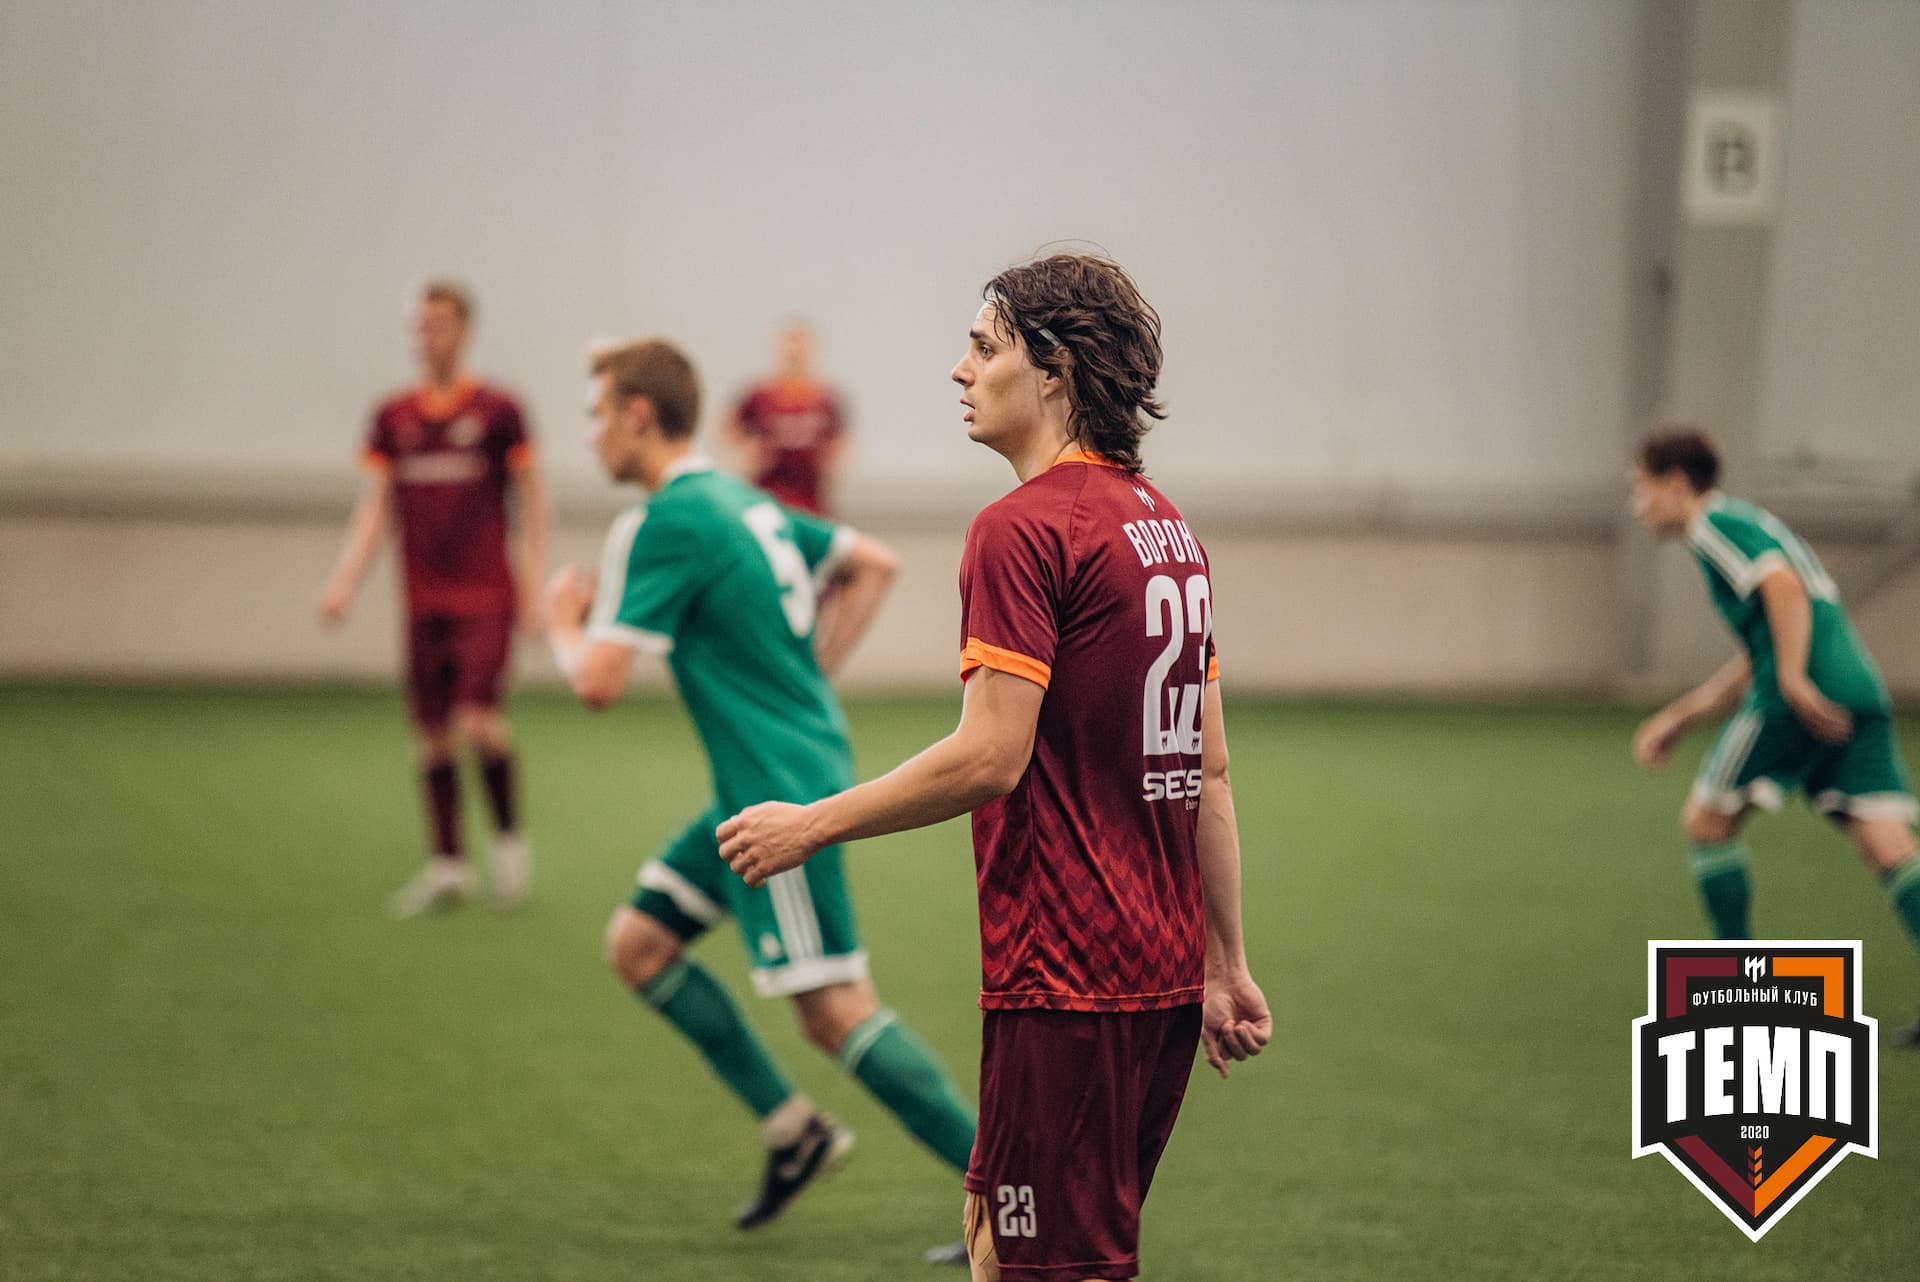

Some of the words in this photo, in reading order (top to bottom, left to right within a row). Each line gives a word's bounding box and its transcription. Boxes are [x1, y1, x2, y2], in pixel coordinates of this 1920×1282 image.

[742, 501, 815, 637] 5
[1122, 519, 1205, 568] ВОРОН
[1143, 574, 1212, 756] 23
[997, 1184, 1037, 1237] 23
